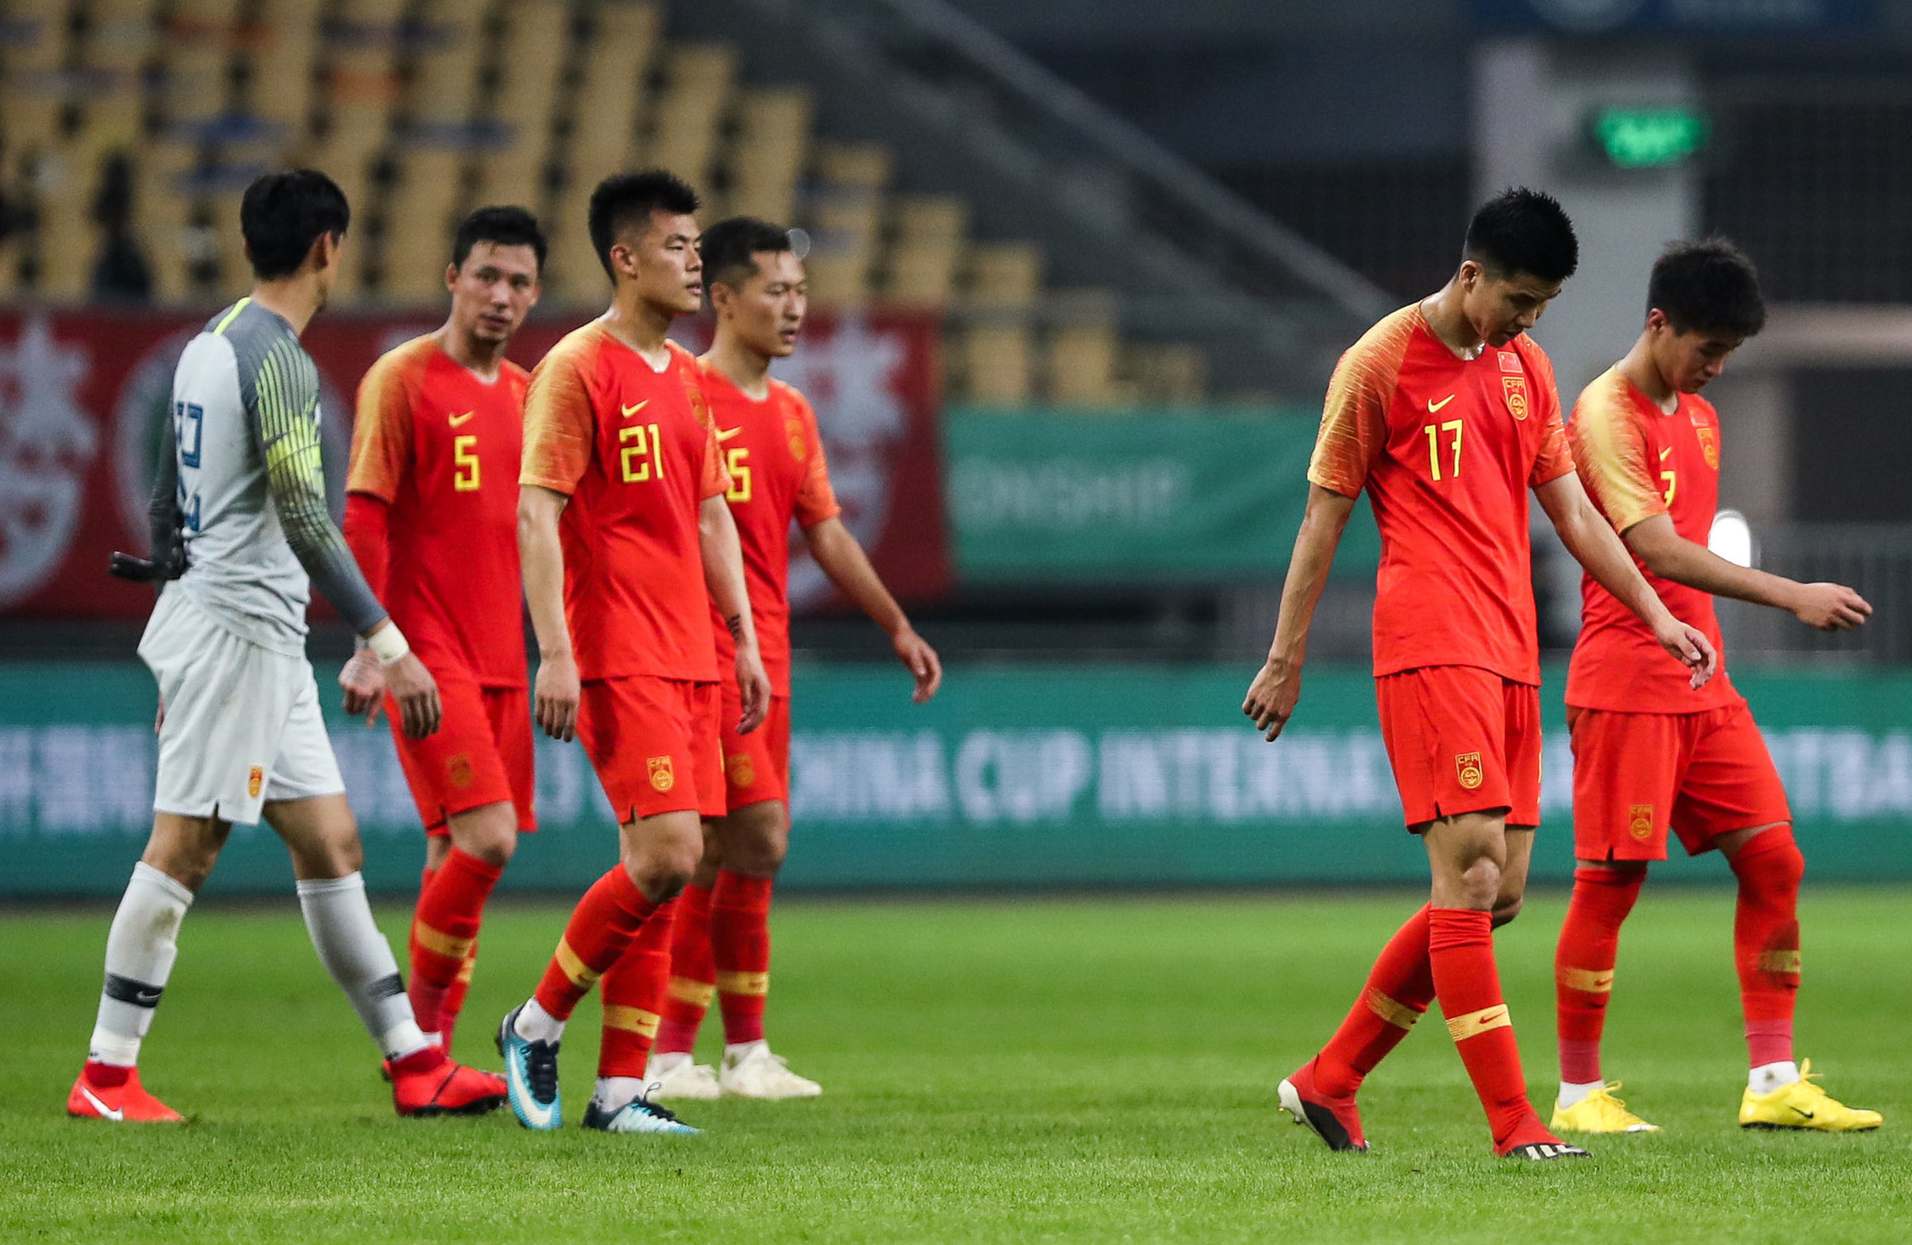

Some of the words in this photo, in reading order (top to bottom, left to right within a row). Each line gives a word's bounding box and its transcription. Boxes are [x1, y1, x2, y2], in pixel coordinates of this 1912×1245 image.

[454, 435, 480, 491] 5
[619, 423, 664, 482] 21
[1424, 419, 1463, 481] 17
[955, 729, 1092, 824] CUP
[1098, 729, 1405, 824] INTERNA
